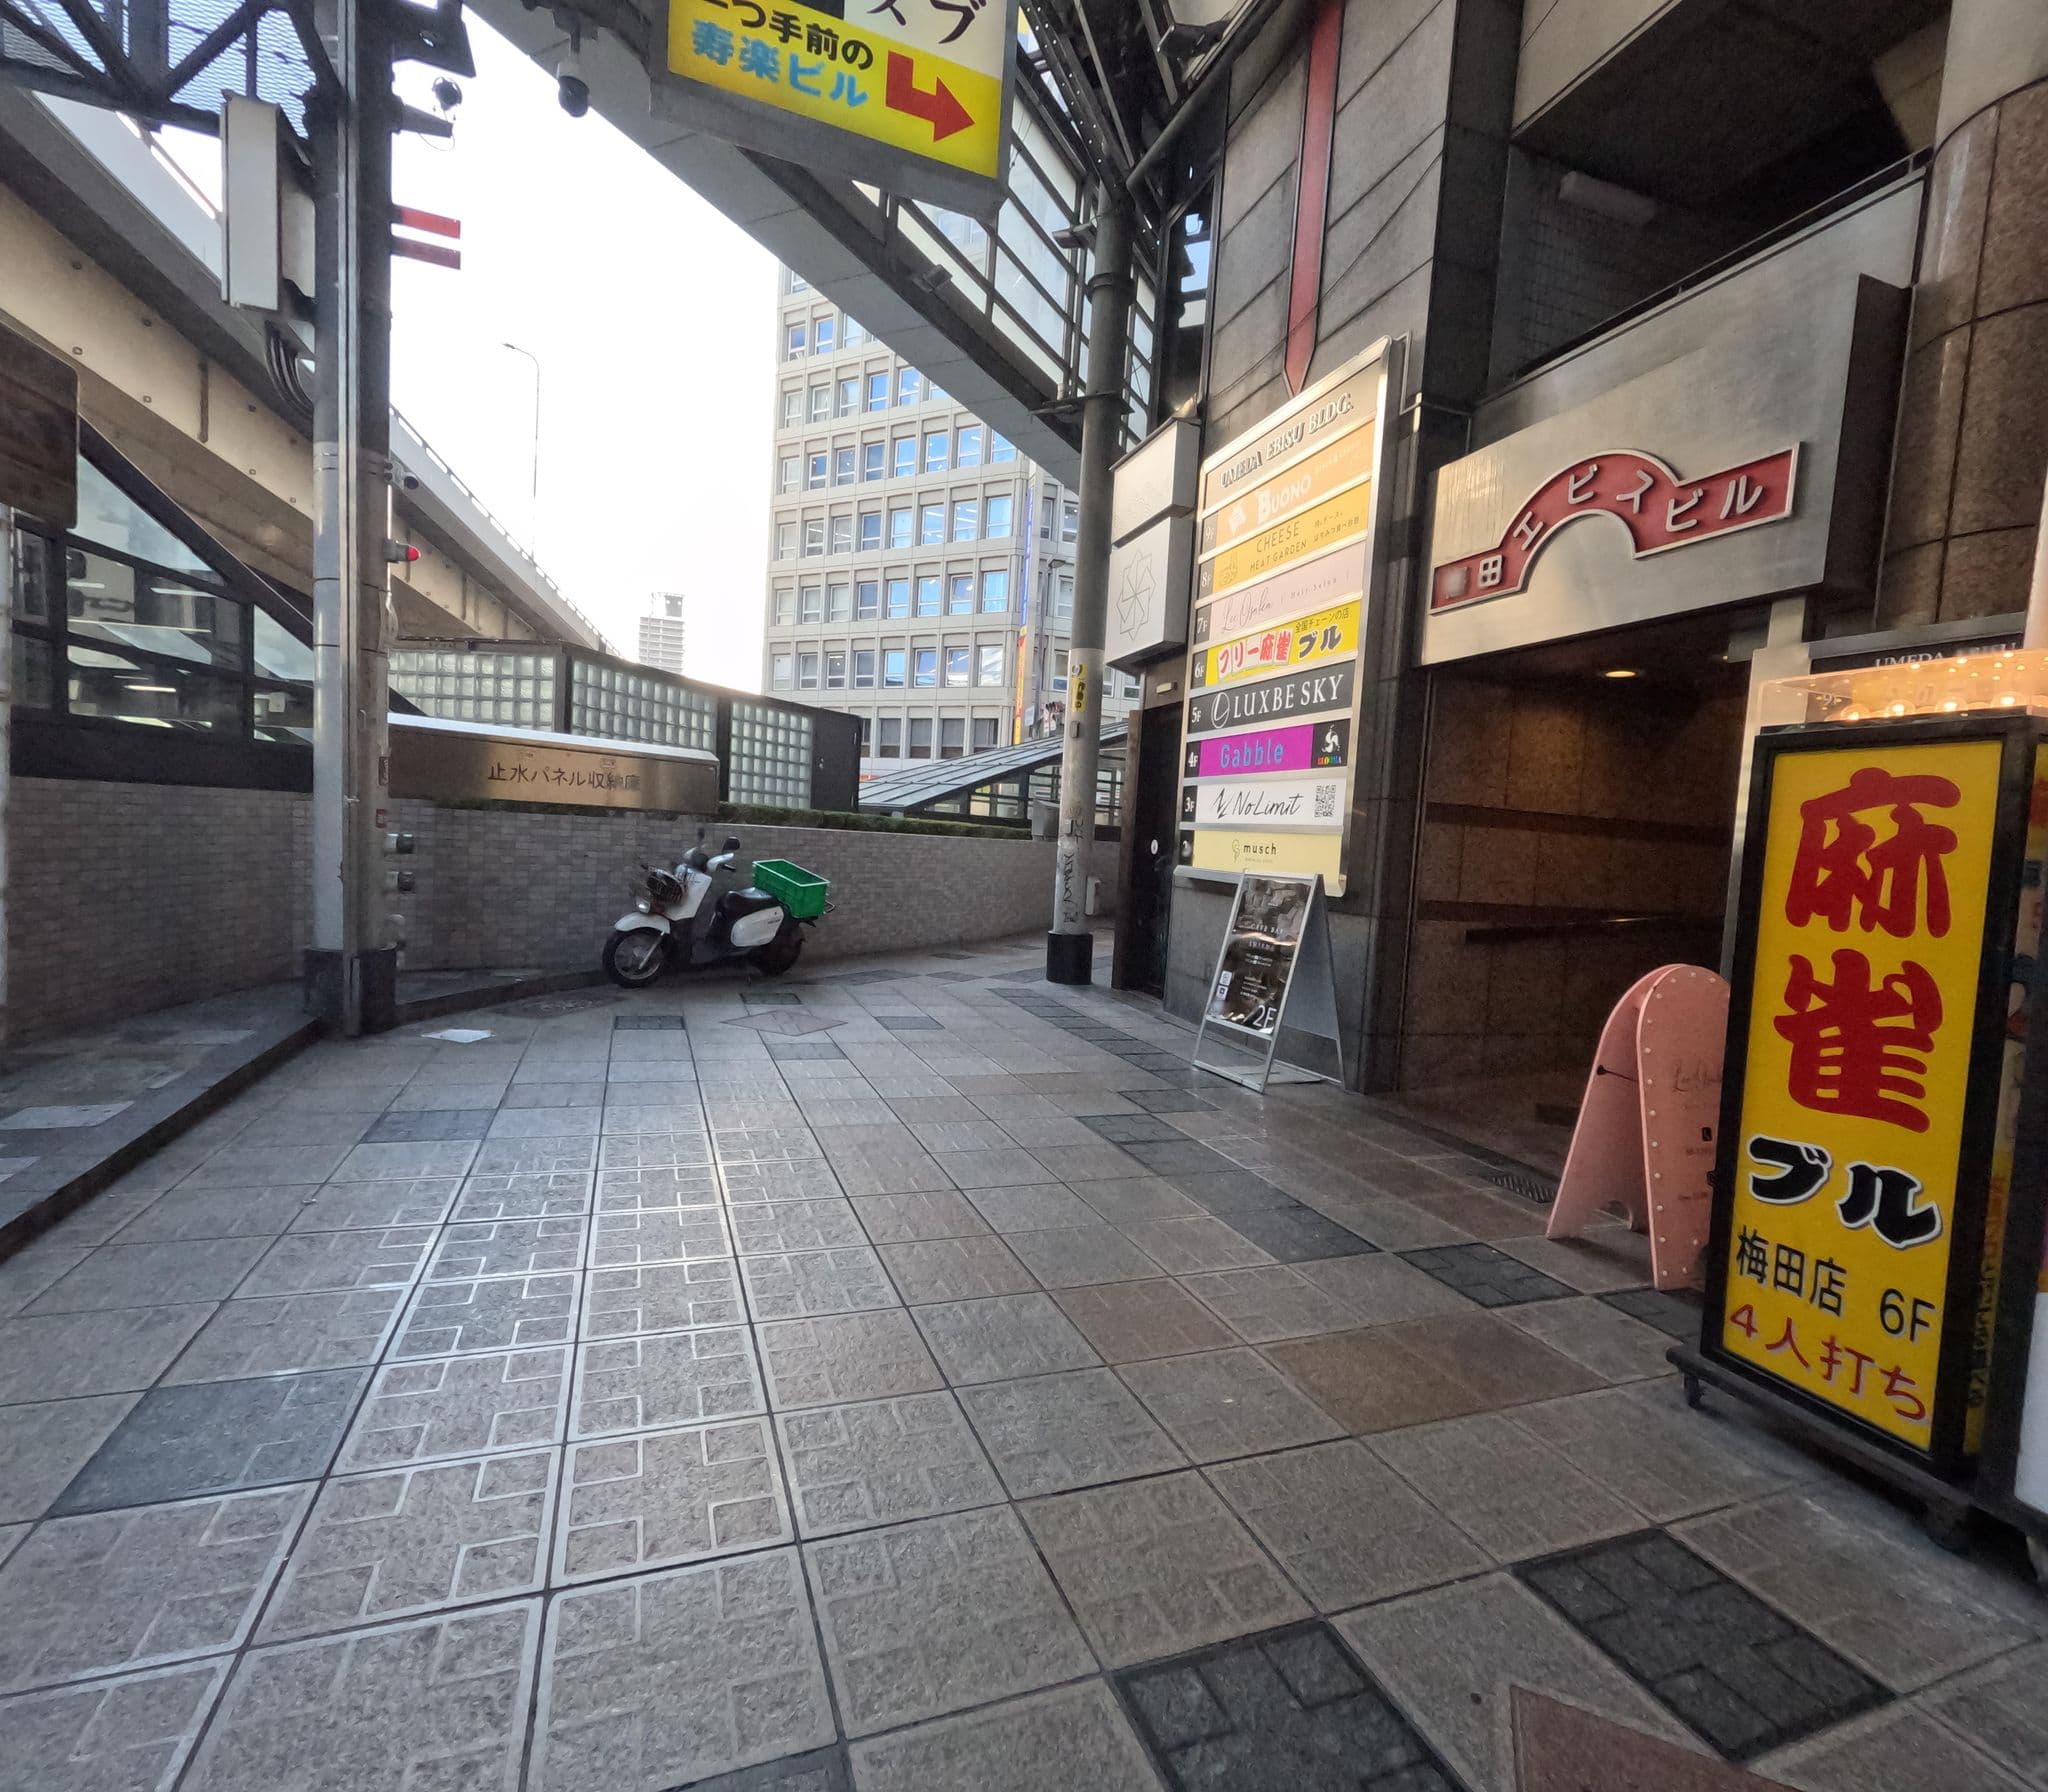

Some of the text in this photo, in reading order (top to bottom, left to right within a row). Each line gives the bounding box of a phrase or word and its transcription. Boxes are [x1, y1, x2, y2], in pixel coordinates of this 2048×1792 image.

[691, 20, 869, 107] 寿楽ビル
[1256, 521, 1300, 553] CHEESE
[1444, 463, 1763, 599] 田エビスビル
[1272, 539, 1307, 561] GARDEN
[1201, 571, 1212, 588] 8F
[1196, 616, 1208, 634] 7F
[1299, 624, 1342, 659] ブル
[1194, 663, 1205, 678] 6F
[1233, 673, 1344, 719] LUXBE SKY
[1191, 706, 1201, 724] 5F
[1188, 752, 1199, 768] 4F
[1220, 738, 1285, 769] Gabble
[1184, 796, 1195, 812] 3F
[1243, 842, 1277, 855] musch
[1772, 766, 1962, 1133] 麻雀
[1253, 1004, 1277, 1029] 2F
[1748, 1136, 1943, 1250] ブル
[1735, 1224, 1935, 1342] 梅田店 6F
[1730, 1303, 1927, 1420] 4人打ち
